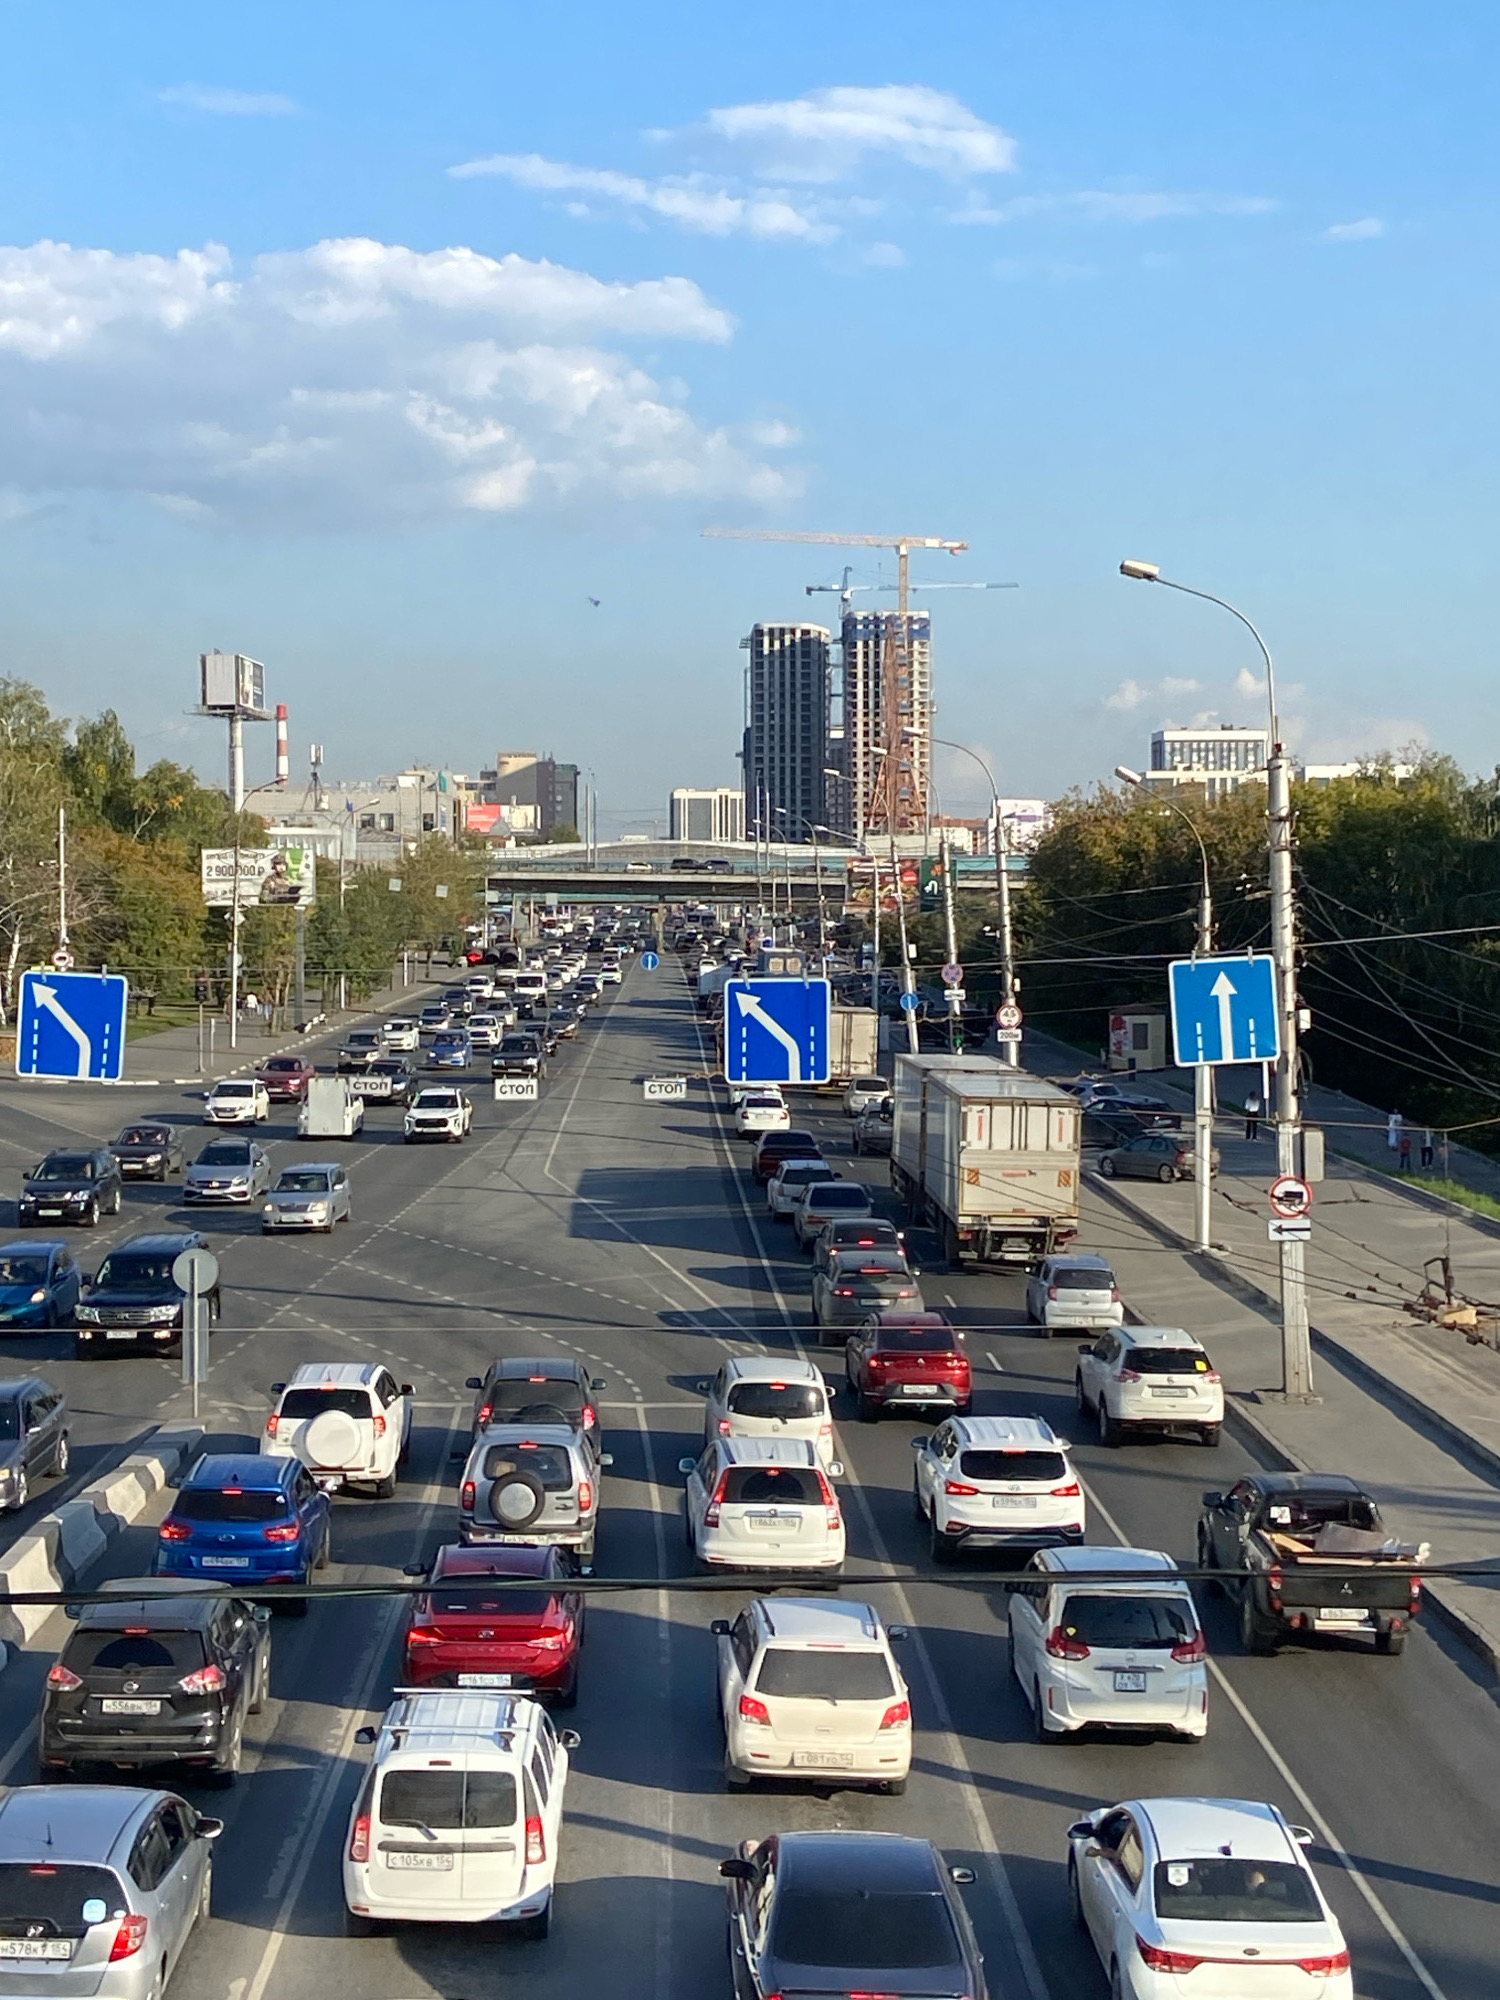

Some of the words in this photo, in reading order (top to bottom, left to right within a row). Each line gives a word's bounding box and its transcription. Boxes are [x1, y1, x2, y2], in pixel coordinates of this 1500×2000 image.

[206, 865, 213, 877] 2
[215, 865, 234, 877] 900
[353, 1081, 388, 1090] СТОП
[500, 1084, 534, 1095] СТОП
[648, 1083, 682, 1094] СТОП
